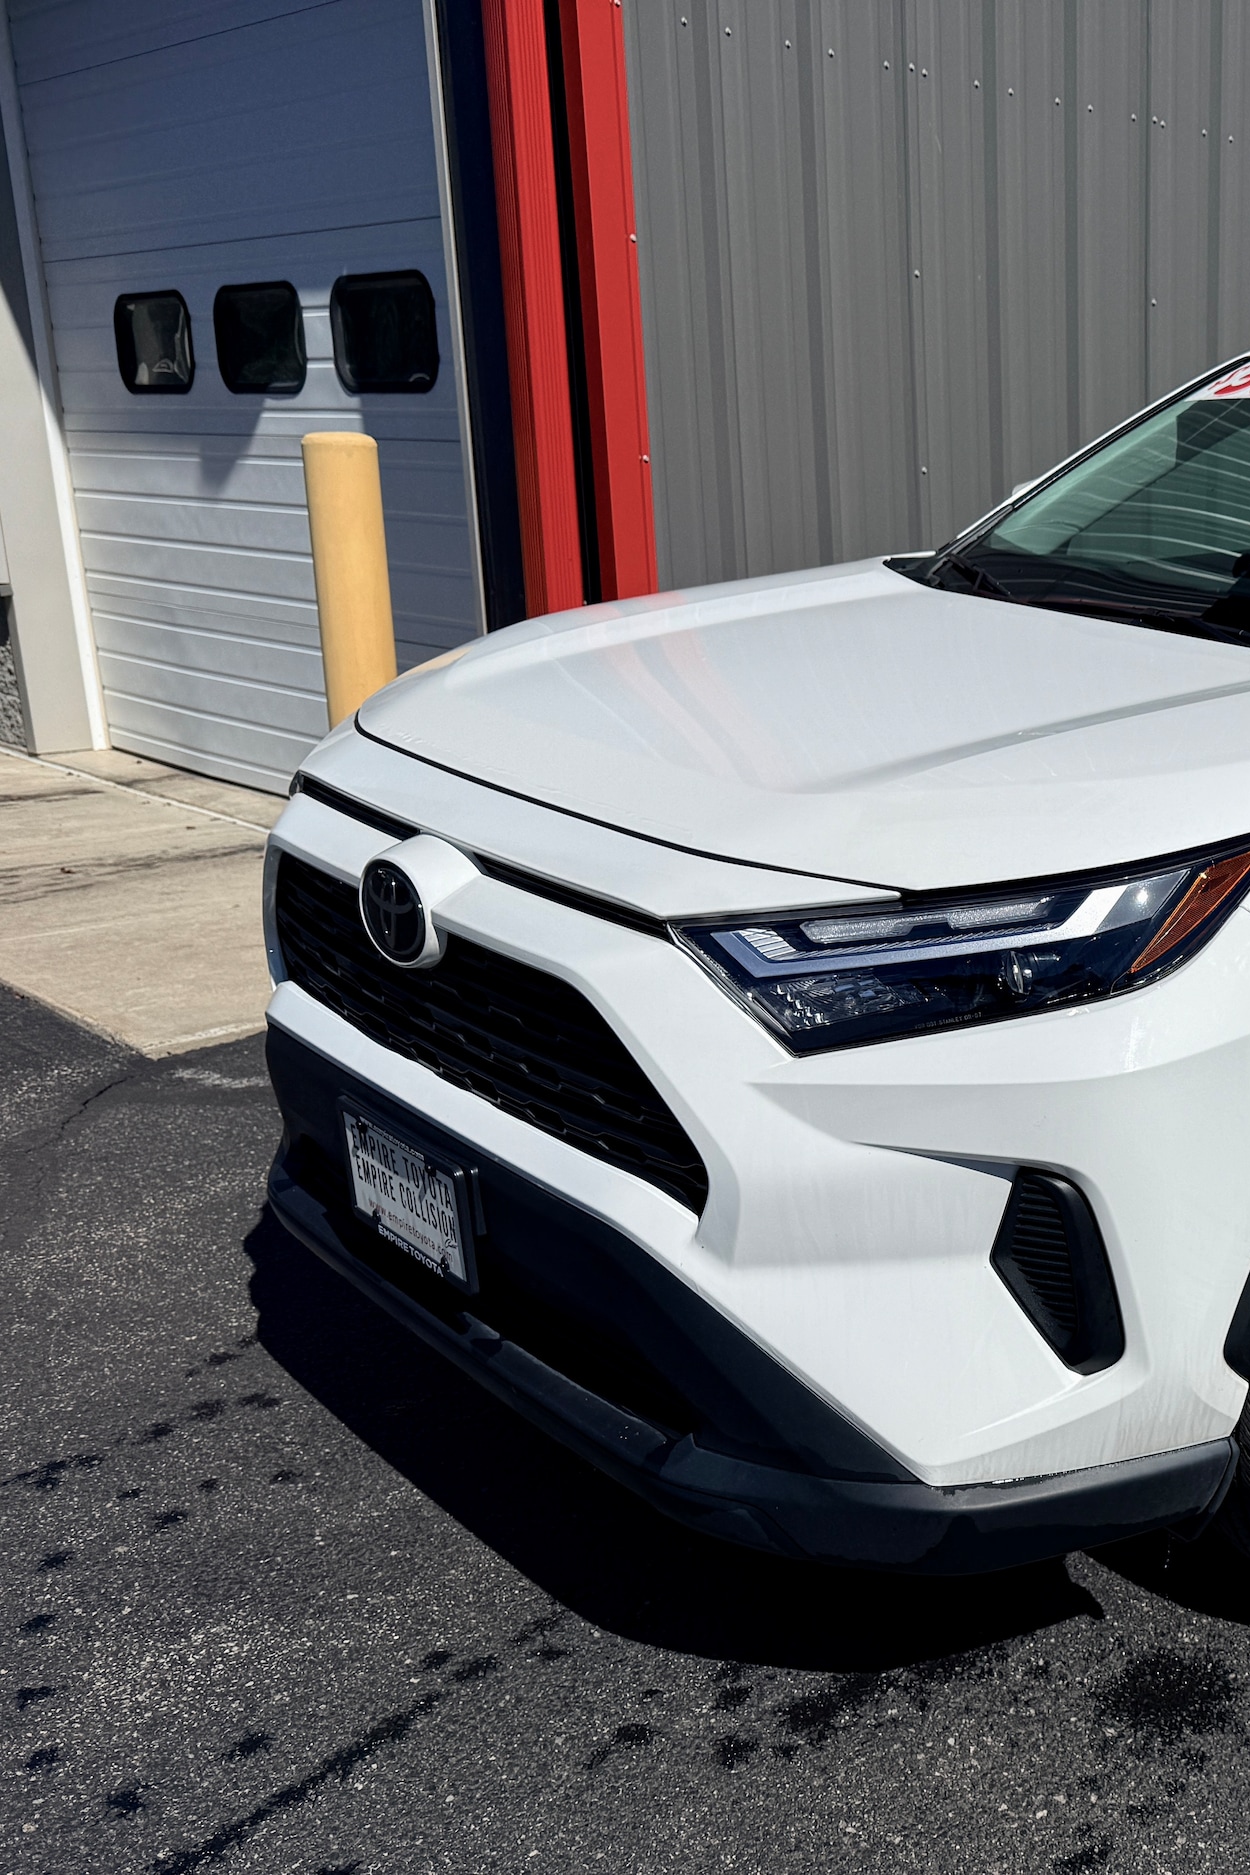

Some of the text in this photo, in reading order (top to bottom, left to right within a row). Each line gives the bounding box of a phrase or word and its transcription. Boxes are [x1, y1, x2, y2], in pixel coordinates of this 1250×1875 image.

[351, 1123, 454, 1212] EMPIRE TOYOTA
[356, 1155, 457, 1242] EMPIRE COLLISION
